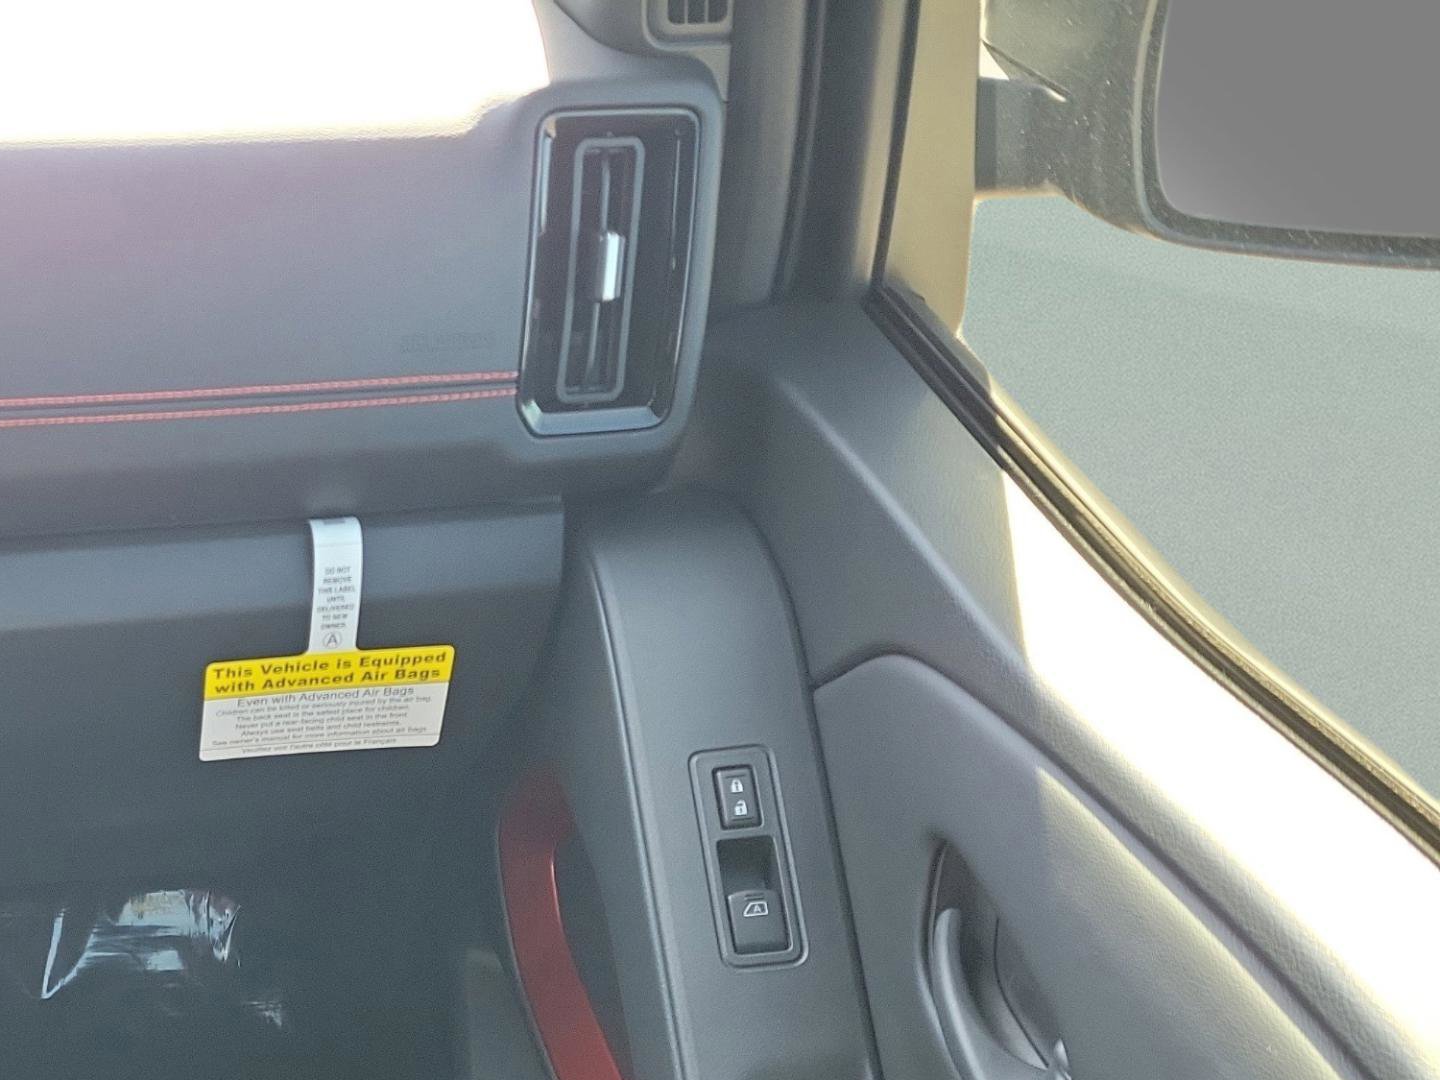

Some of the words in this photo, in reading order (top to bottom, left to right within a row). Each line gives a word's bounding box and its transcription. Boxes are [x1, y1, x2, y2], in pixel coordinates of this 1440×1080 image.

[214, 665, 253, 680] This
[260, 660, 328, 676] Vehicle
[336, 658, 352, 670] is
[359, 652, 446, 670] Equipped
[215, 677, 255, 694] with
[262, 672, 358, 690] Advanced
[361, 668, 389, 683] Air
[394, 666, 441, 682] Bags
[237, 696, 270, 708] Even
[272, 693, 296, 705] with
[299, 689, 360, 702] Advanced
[362, 687, 380, 699] Air
[383, 685, 415, 698] Bags
